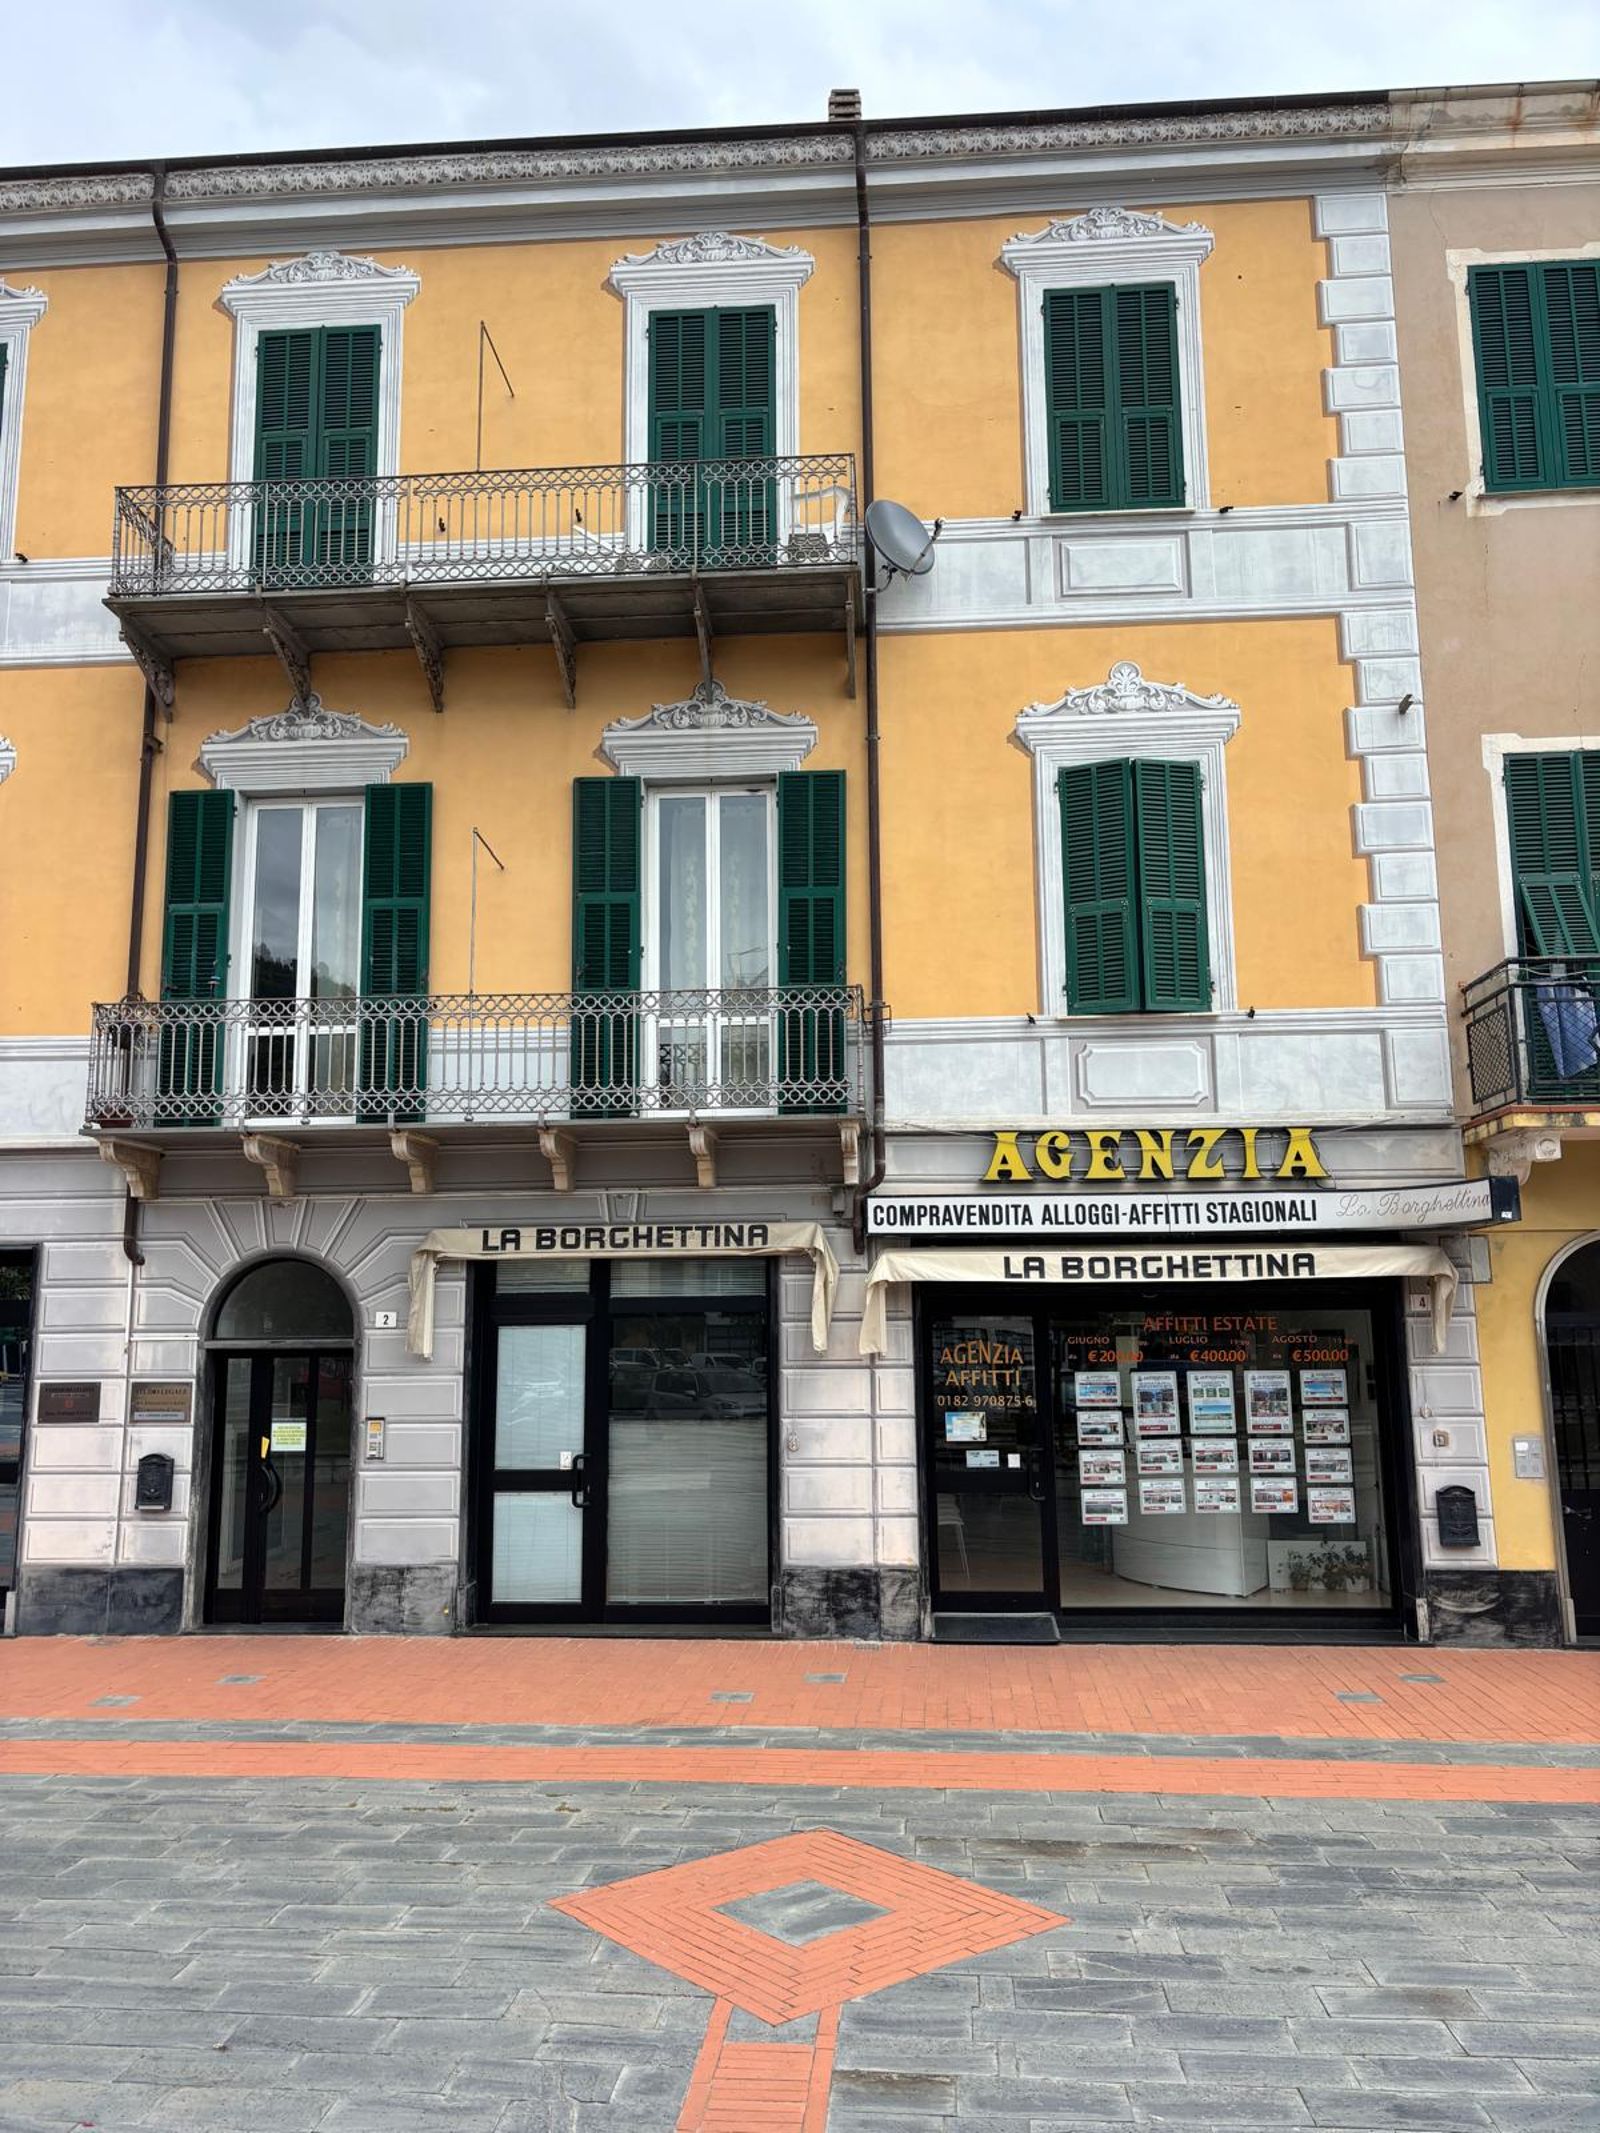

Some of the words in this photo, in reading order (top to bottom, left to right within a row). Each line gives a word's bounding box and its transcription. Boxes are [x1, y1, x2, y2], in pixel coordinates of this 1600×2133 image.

[983, 1128, 1328, 1182] AGENZIA
[873, 1203, 1033, 1227] COMPRAVENDITA
[1206, 1198, 1317, 1224] STAGIONALI
[481, 1228, 521, 1251] LA
[536, 1224, 769, 1249] BORGHETTINA
[1003, 1256, 1046, 1279] LA
[1061, 1252, 1316, 1279] BORGHETTINA
[1419, 1296, 1427, 1308] 4
[383, 1313, 390, 1326] 2
[1143, 1316, 1208, 1331] AFFITTI
[1213, 1315, 1279, 1331] ESTATE
[1067, 1336, 1110, 1345] GIUGNO
[1169, 1335, 1209, 1345] LUGLIO
[1271, 1335, 1318, 1344] AGOSTO
[940, 1340, 1024, 1365] AGENZIA
[945, 1370, 1021, 1387] AFFITTI
[937, 1395, 969, 1407] 0182
[973, 1395, 1033, 1407] 970875-6
